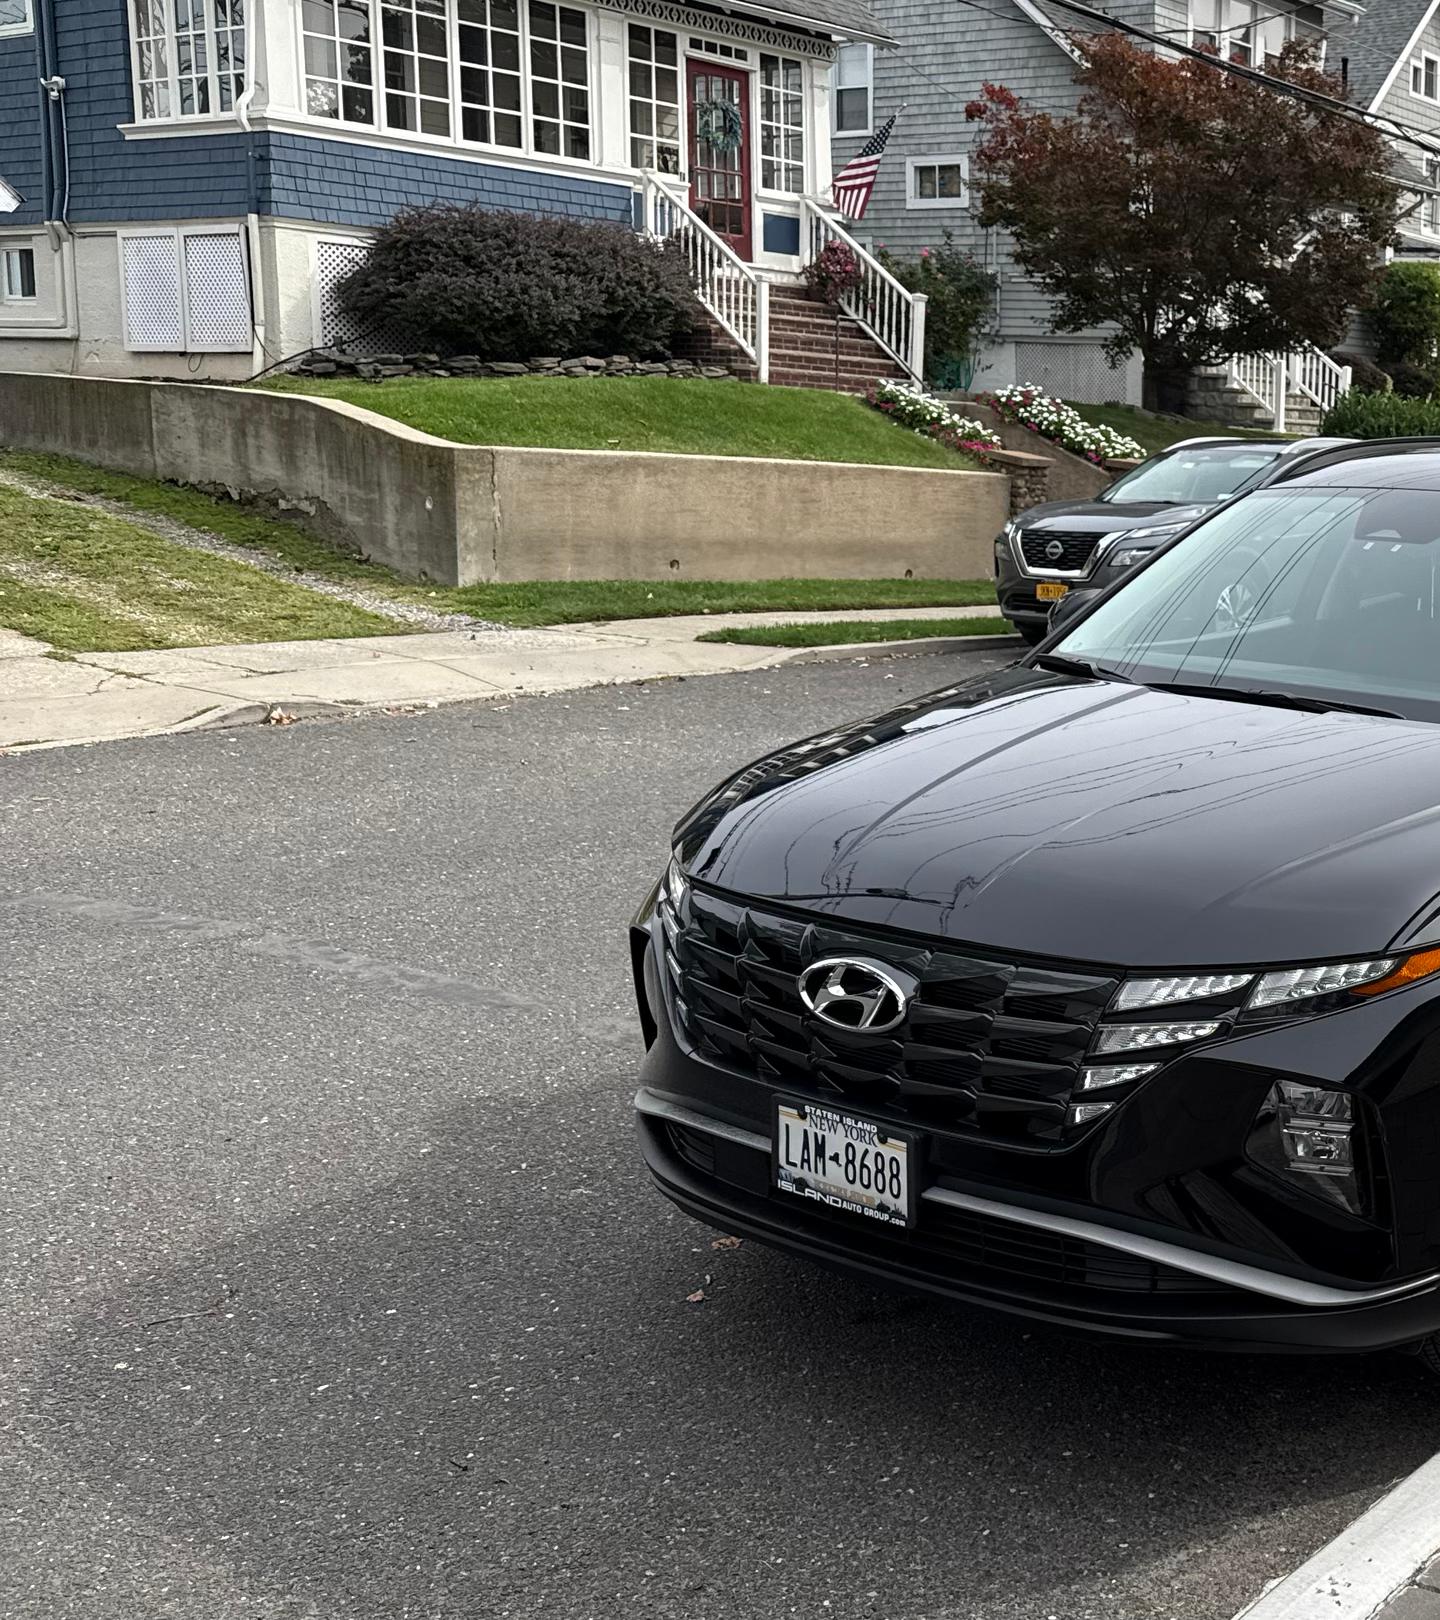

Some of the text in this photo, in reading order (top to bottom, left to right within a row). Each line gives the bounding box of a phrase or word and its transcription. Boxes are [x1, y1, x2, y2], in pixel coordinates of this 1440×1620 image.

[804, 1105, 878, 1133] STATEN ISLAND
[808, 1114, 878, 1147] NEW YORK
[785, 1123, 827, 1177] LAM
[845, 1142, 901, 1199] 8688
[778, 1179, 842, 1207] ISLAND
[842, 1201, 862, 1214] AUTO
